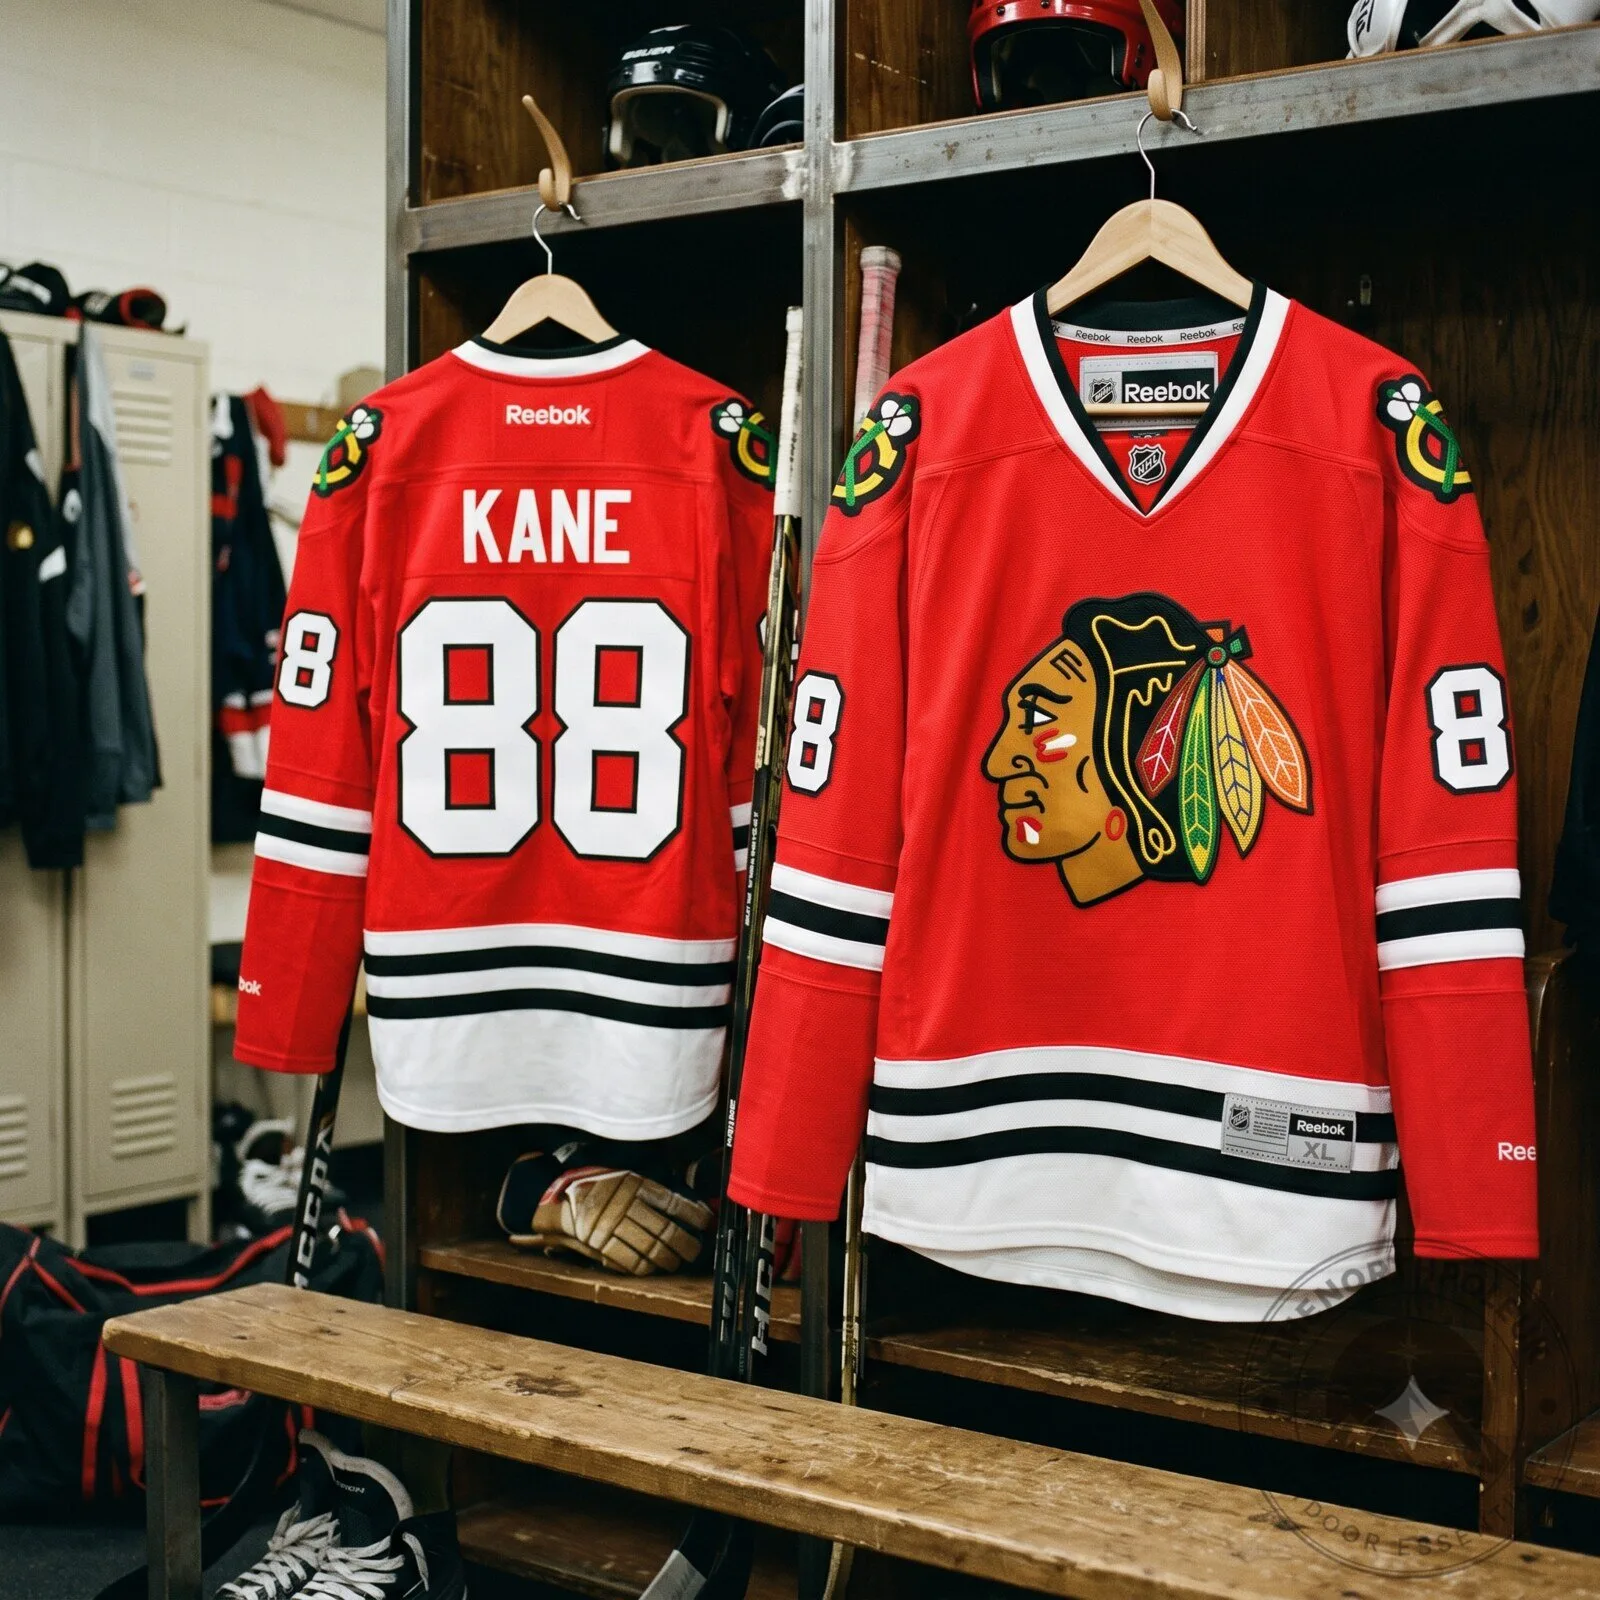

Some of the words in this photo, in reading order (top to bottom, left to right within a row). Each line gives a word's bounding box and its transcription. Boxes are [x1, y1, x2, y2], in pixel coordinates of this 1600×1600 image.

[1075, 329, 1111, 343] Reebok
[1127, 334, 1163, 344] Reebok
[1180, 328, 1217, 342] Reebok
[1124, 381, 1211, 403] Reebok
[505, 404, 591, 426] Reebok
[1138, 454, 1158, 476] NHL
[463, 488, 632, 565] KANE
[278, 610, 338, 710] 8
[398, 596, 691, 862] 88
[786, 672, 844, 796] 8
[1425, 664, 1514, 794] 8
[1296, 1119, 1346, 1136] Reebok
[1302, 1140, 1337, 1162] XL
